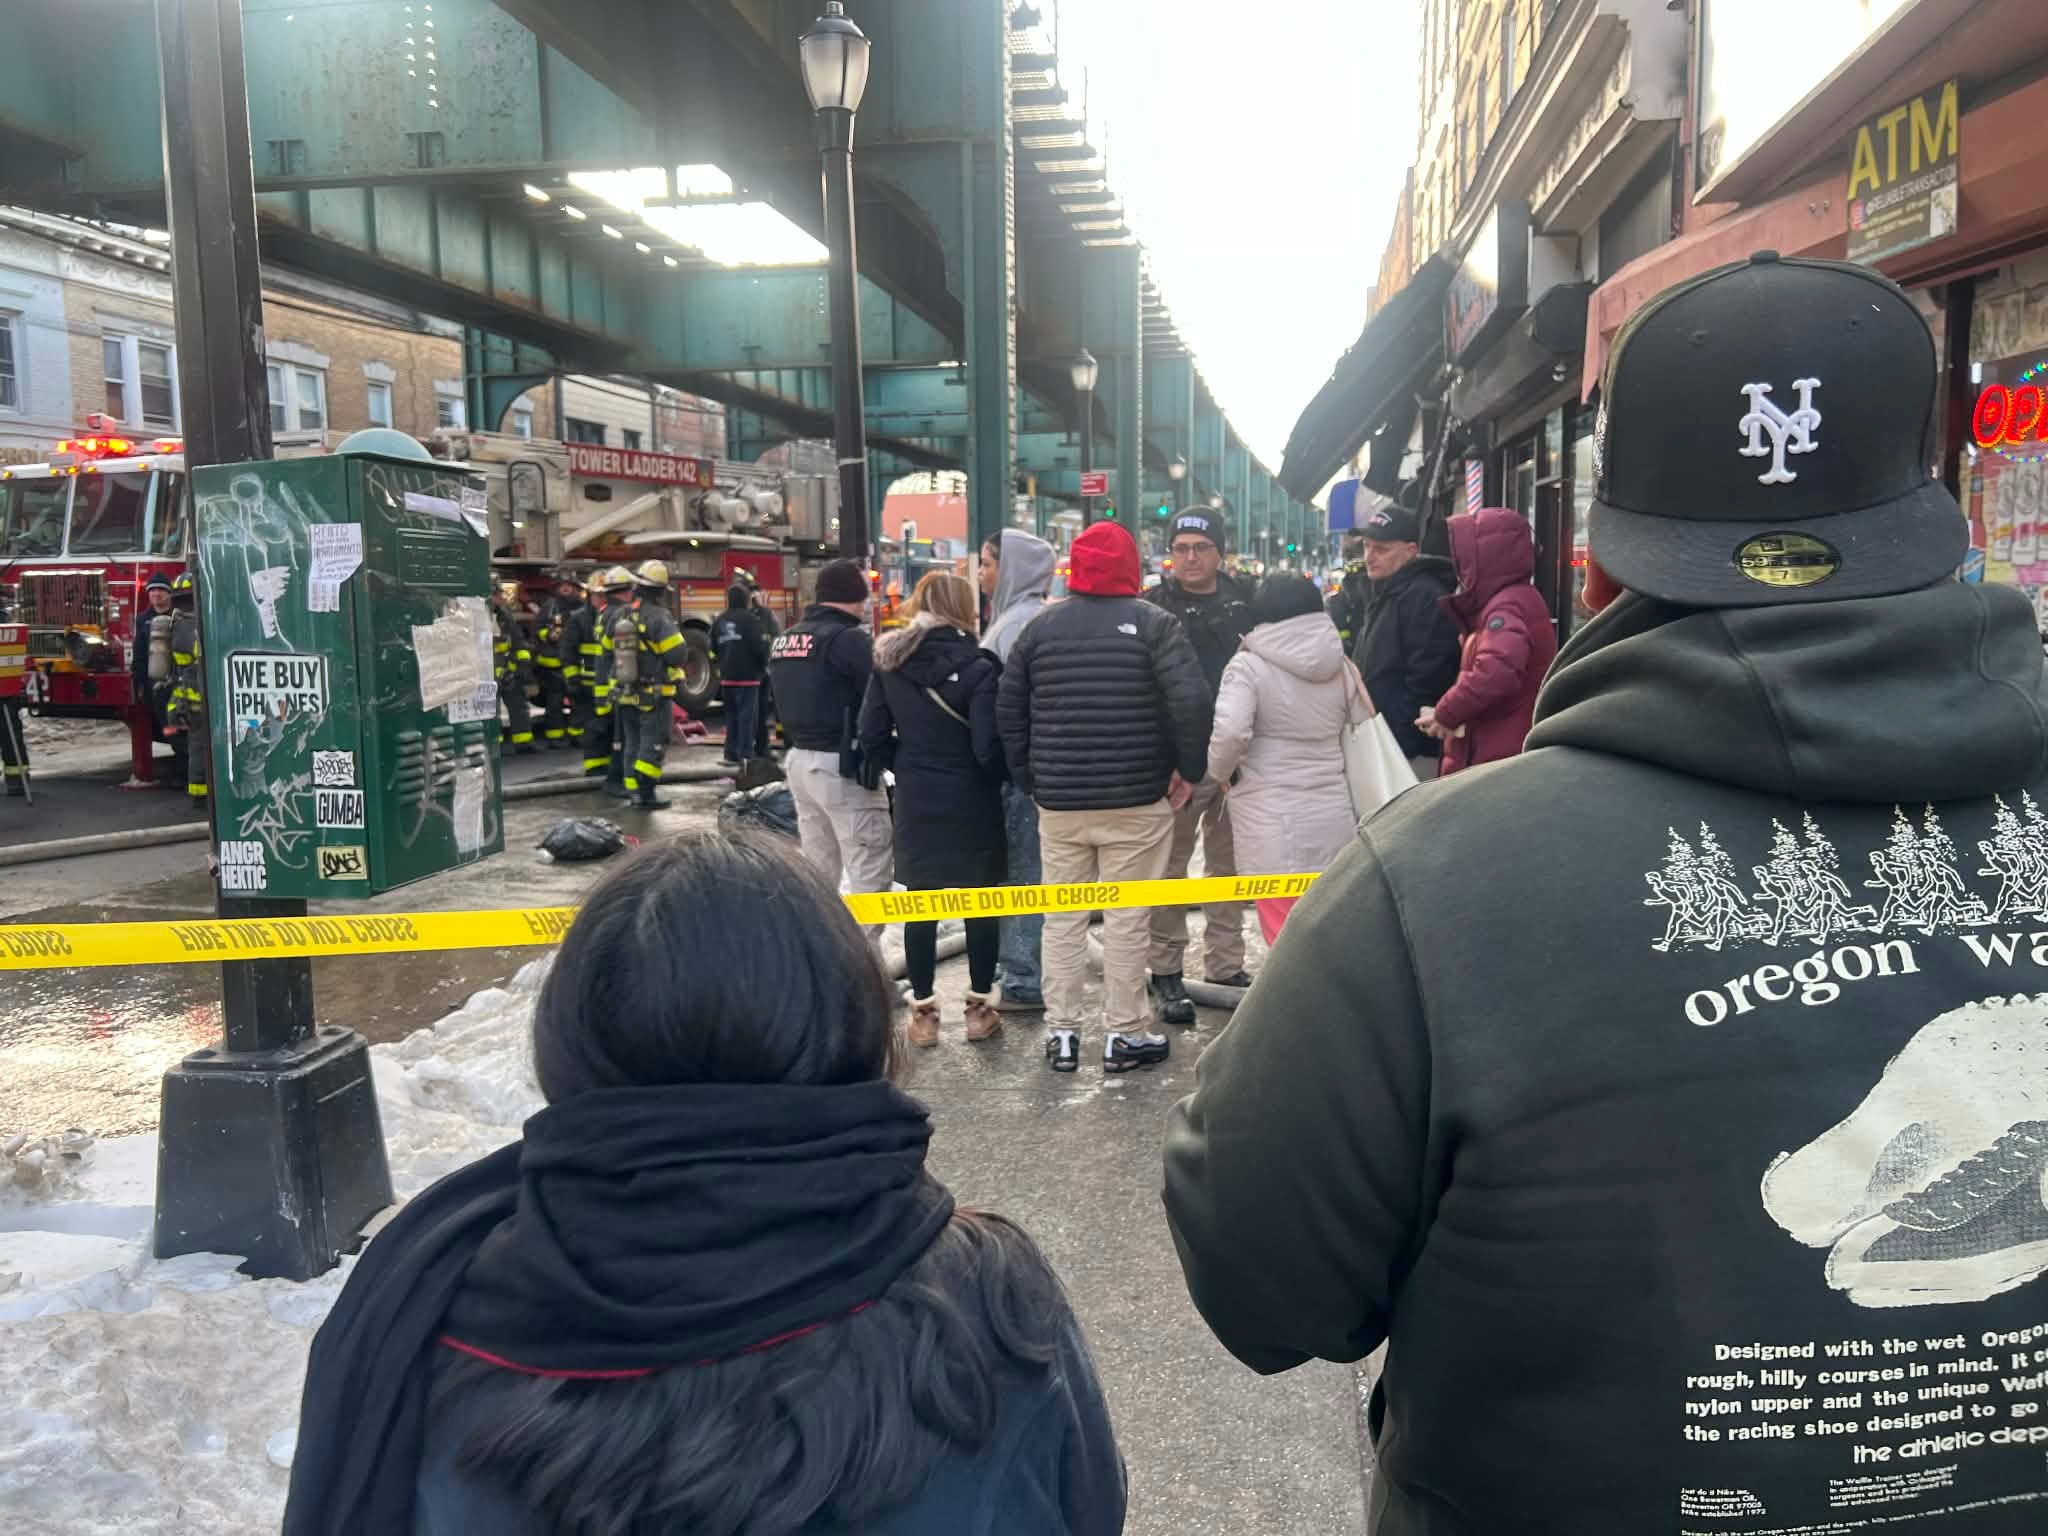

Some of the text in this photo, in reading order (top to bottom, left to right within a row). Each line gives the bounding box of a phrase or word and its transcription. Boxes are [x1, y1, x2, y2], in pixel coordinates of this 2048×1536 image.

[1848, 79, 1959, 201] ATM
[569, 447, 697, 483] TOWER LADDER 142
[234, 660, 318, 689] WE BUY
[235, 692, 320, 715] iPHNES
[318, 792, 363, 825] GUMBA
[1684, 939, 1920, 1027] oregon
[1714, 1341, 1815, 1361] Designed
[1824, 1339, 1874, 1357] with
[1882, 1338, 1918, 1355] the
[1924, 1334, 1966, 1350] wet
[1686, 1370, 1755, 1391] rough,
[1760, 1369, 1807, 1390] hilly
[1817, 1367, 1905, 1384] courses
[1909, 1362, 1929, 1378] in
[1937, 1357, 1999, 1375] mind.
[2011, 1352, 2029, 1370] It
[1685, 1399, 1742, 1417] nylon
[1751, 1397, 1813, 1414] upper
[1822, 1392, 1862, 1409] and
[1872, 1390, 1909, 1407] the
[1917, 1382, 1990, 1400] unique
[1682, 1402, 2039, 1441] the racing shoe designed to go
[1853, 1444, 1892, 1464] the
[1898, 1430, 1985, 1458] athletic
